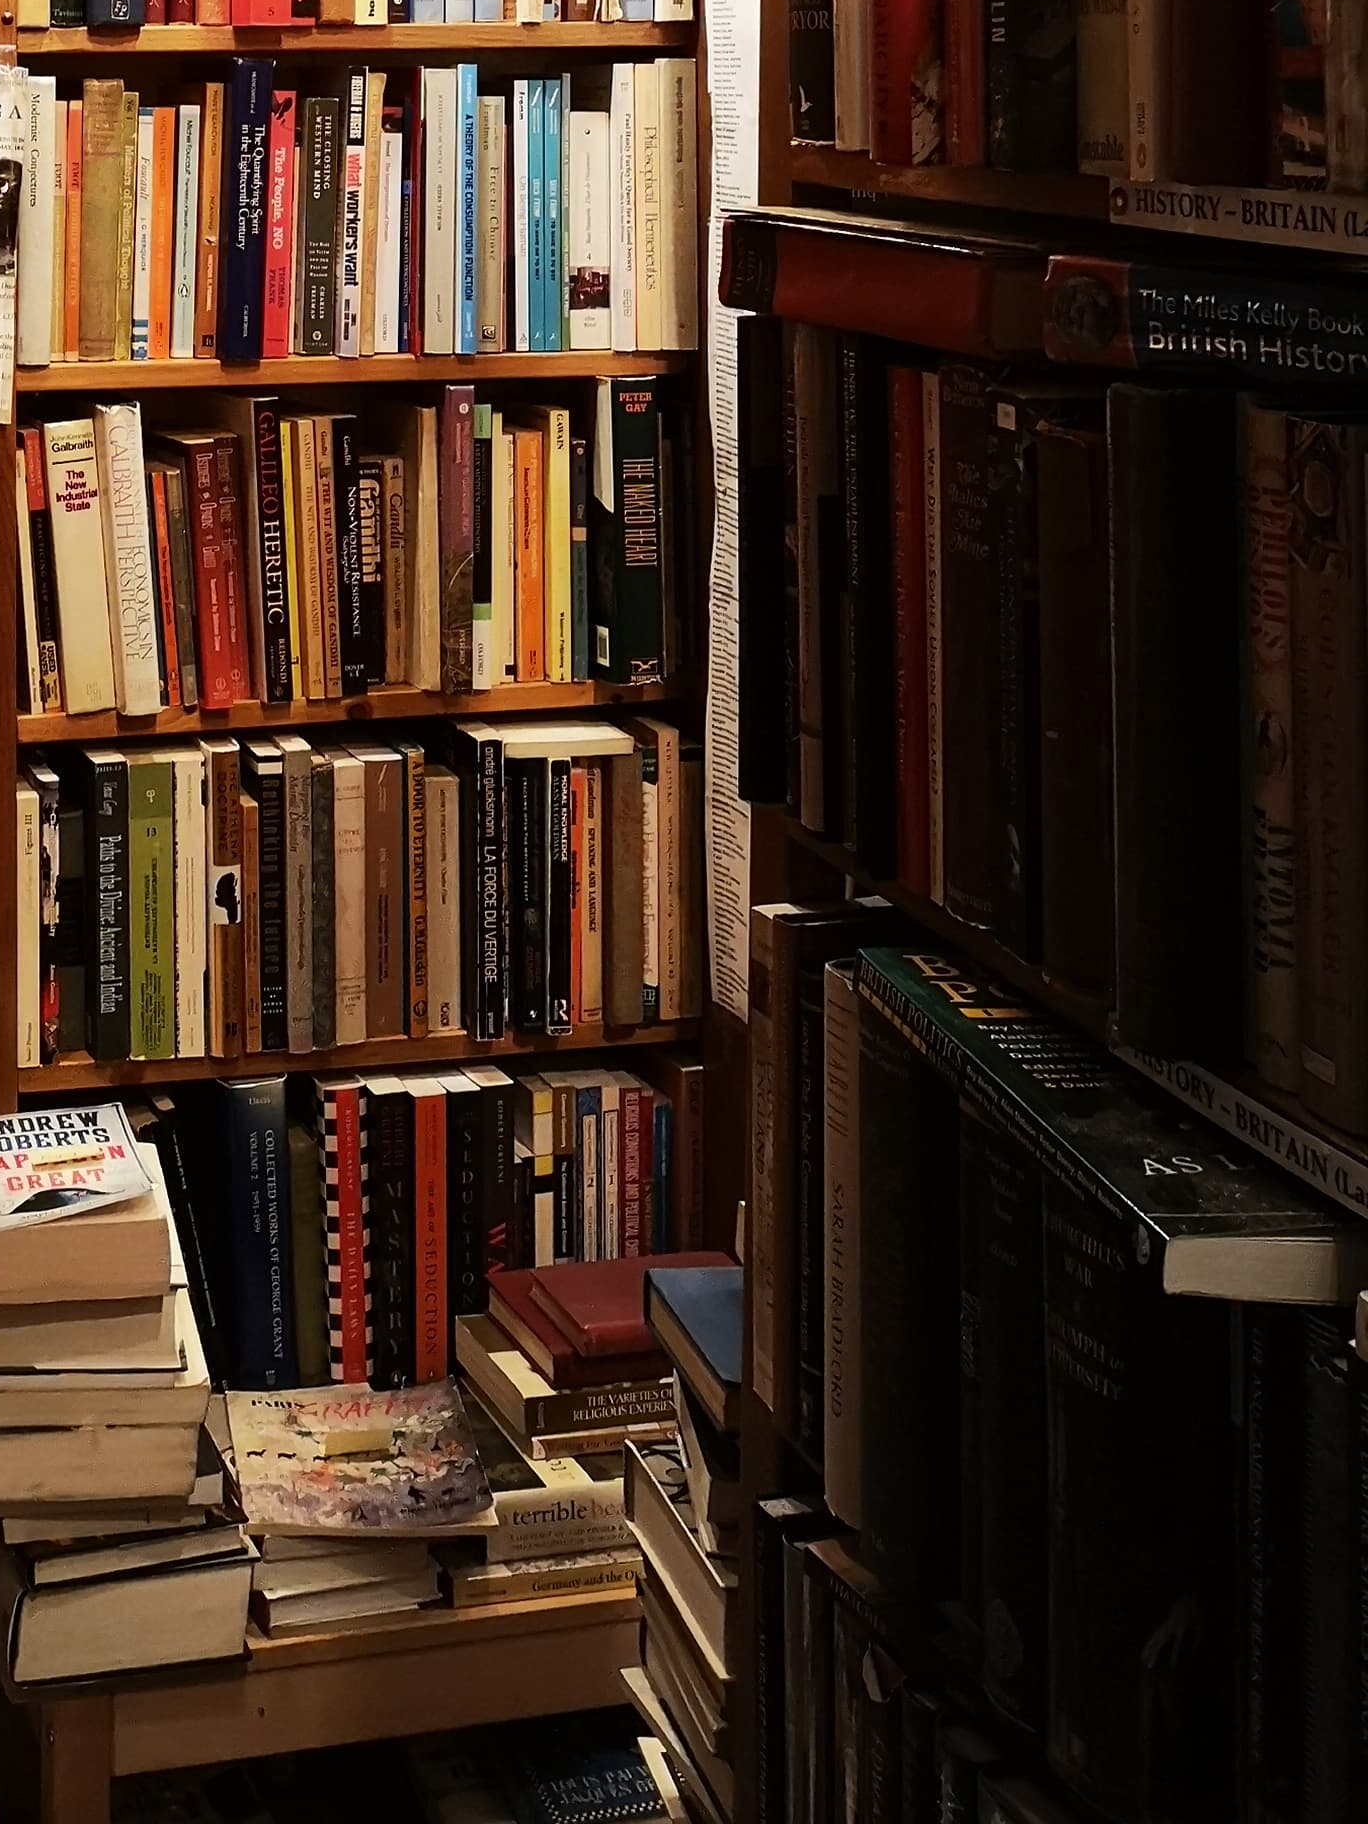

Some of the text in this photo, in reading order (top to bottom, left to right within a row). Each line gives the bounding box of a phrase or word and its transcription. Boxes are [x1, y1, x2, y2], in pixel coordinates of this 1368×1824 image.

[465, 122, 474, 156] THEORY
[465, 159, 474, 170] OF
[465, 172, 474, 190] THE
[343, 154, 363, 287] what workers want
[464, 191, 474, 254] CONSUMPTION
[1136, 188, 1221, 221] HISTORY
[1241, 199, 1336, 234] BRITAIN
[464, 257, 474, 301] FUNCTION
[1140, 288, 1365, 337] The Miles Kelly Book
[1148, 320, 1247, 360] British
[65, 471, 86, 479] The
[65, 482, 88, 491] New
[56, 494, 98, 503] Industrial
[64, 503, 92, 513] State
[622, 457, 658, 568] THE NAKED HEART
[257, 411, 288, 684] GALILEO HERETIC REDONDI
[483, 746, 497, 983] andré glucksmann LA FORCE DU VERTIGE
[6, 1168, 105, 1194] GREAT
[264, 1130, 284, 1359] COLLECTED WORKS OF GEORGE GRANT
[512, 1500, 587, 1528] terrible
